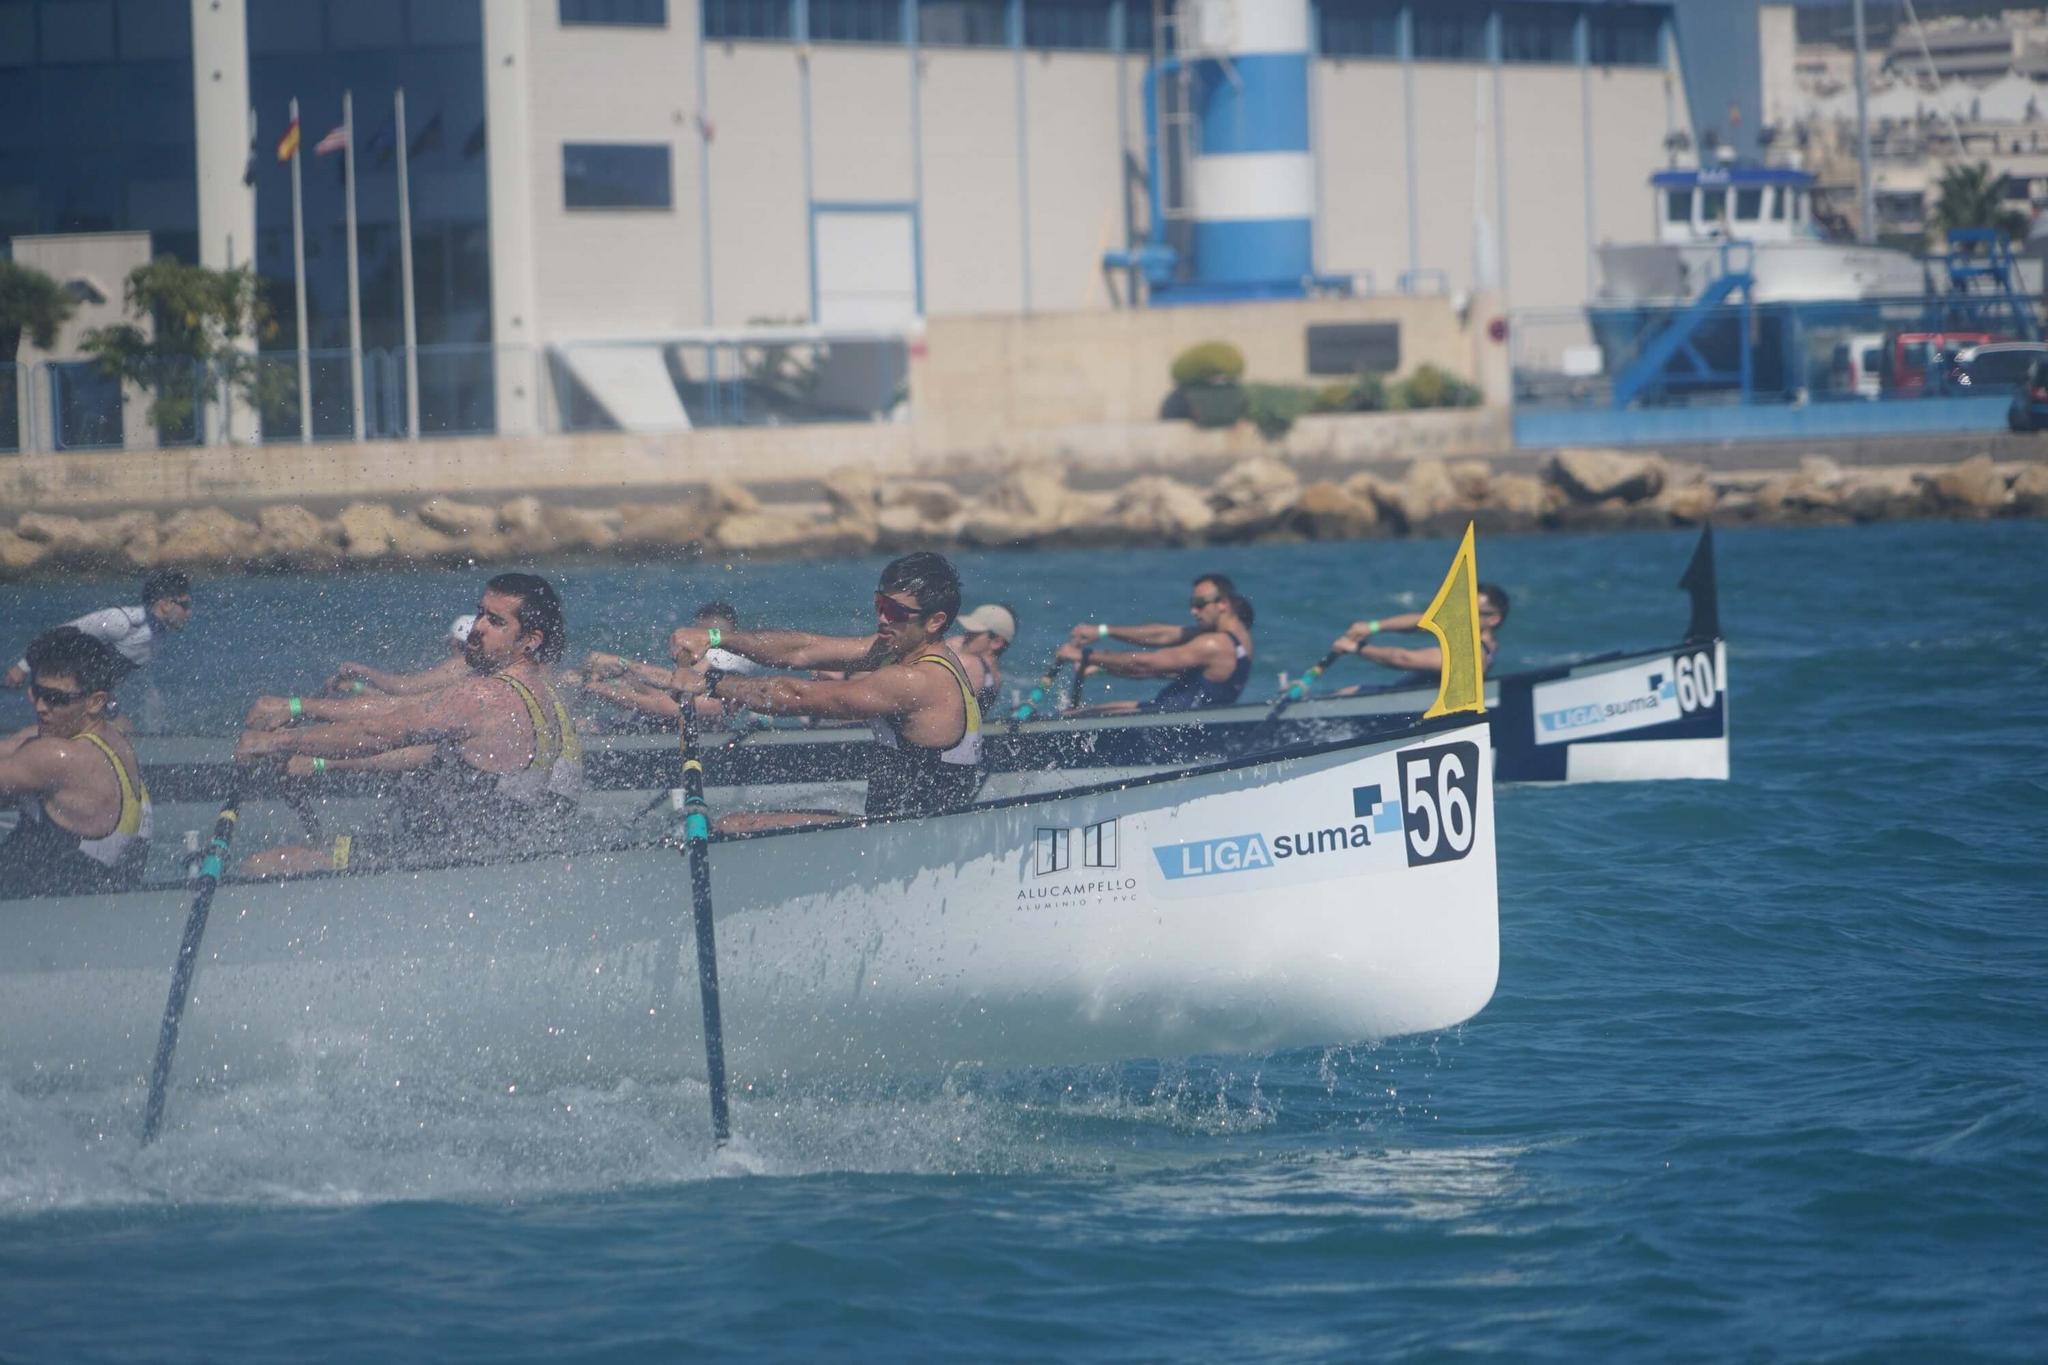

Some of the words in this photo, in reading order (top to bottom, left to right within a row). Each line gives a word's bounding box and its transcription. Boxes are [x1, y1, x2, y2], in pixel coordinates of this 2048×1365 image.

[1675, 651, 1716, 713] 60
[1553, 704, 1603, 730] LIGA
[1604, 695, 1659, 718] suma
[1406, 752, 1475, 858] 56
[1182, 837, 1268, 876] LIGA
[1273, 823, 1371, 859] suma
[1017, 878, 1136, 900] ALUCAMPELLO
[1017, 898, 1086, 912] ALUMINIO
[1113, 894, 1137, 903] PVC
